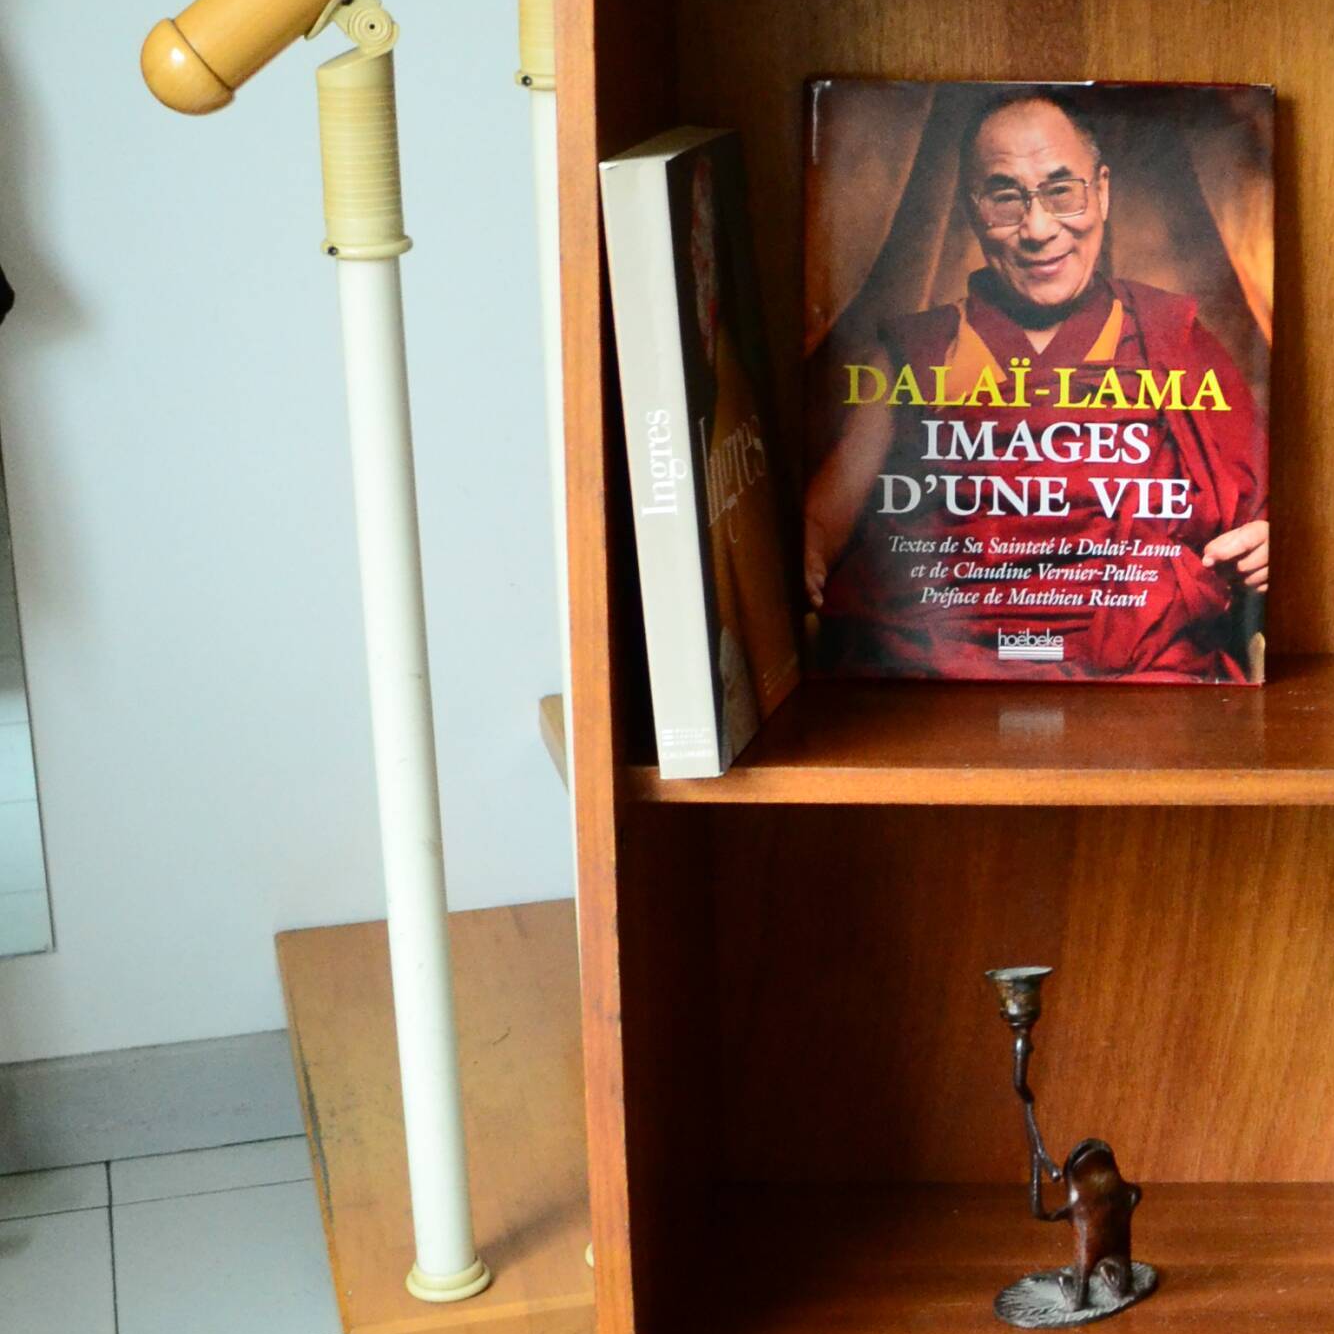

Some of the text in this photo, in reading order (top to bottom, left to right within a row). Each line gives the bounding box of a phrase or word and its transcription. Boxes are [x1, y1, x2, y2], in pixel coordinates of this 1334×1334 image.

[843, 357, 1231, 411] DALAÏ-LAMA
[641, 409, 688, 518] Ingres
[920, 420, 1151, 464] IMAGES
[699, 414, 766, 543] Ingres
[876, 473, 1193, 519] D'UNE VIE
[889, 535, 1182, 557] Textes de Sa Sainteté le Dalaï-Lama
[910, 561, 1159, 582] et de Claudine Vernier-Palliez
[920, 586, 1149, 609] Préface de Matthieu Ricard
[998, 627, 1064, 647] hoëbeke
